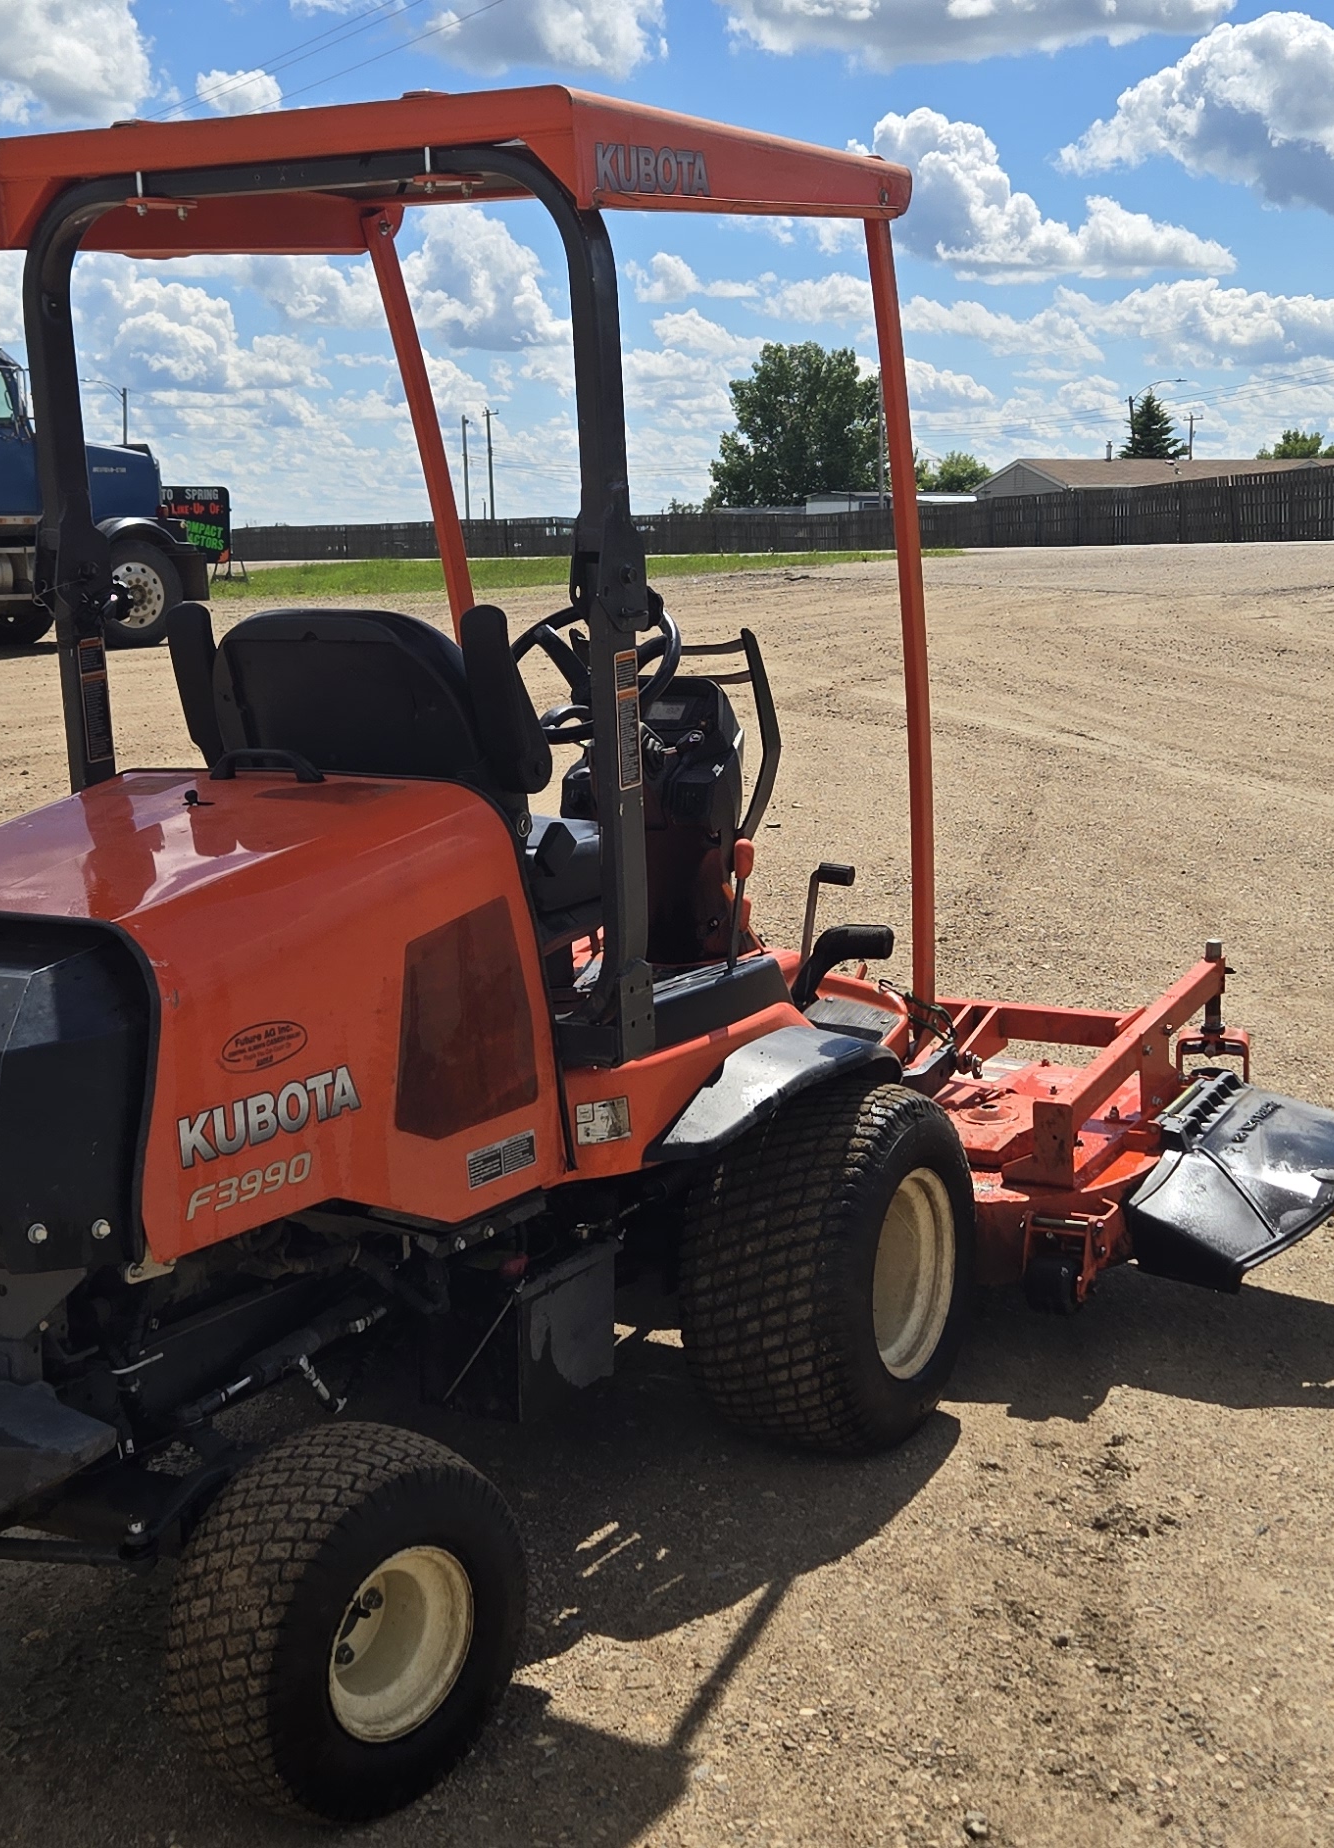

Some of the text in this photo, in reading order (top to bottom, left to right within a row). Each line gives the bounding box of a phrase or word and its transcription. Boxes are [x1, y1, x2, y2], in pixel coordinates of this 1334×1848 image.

[595, 143, 710, 196] KUBOTA
[161, 488, 219, 500] TO SPRING
[186, 520, 224, 539] OMPACT
[188, 532, 225, 551] ACTORS
[234, 1033, 262, 1048] Future
[178, 1065, 361, 1168] KUBOTA
[186, 1152, 311, 1221] F3990
